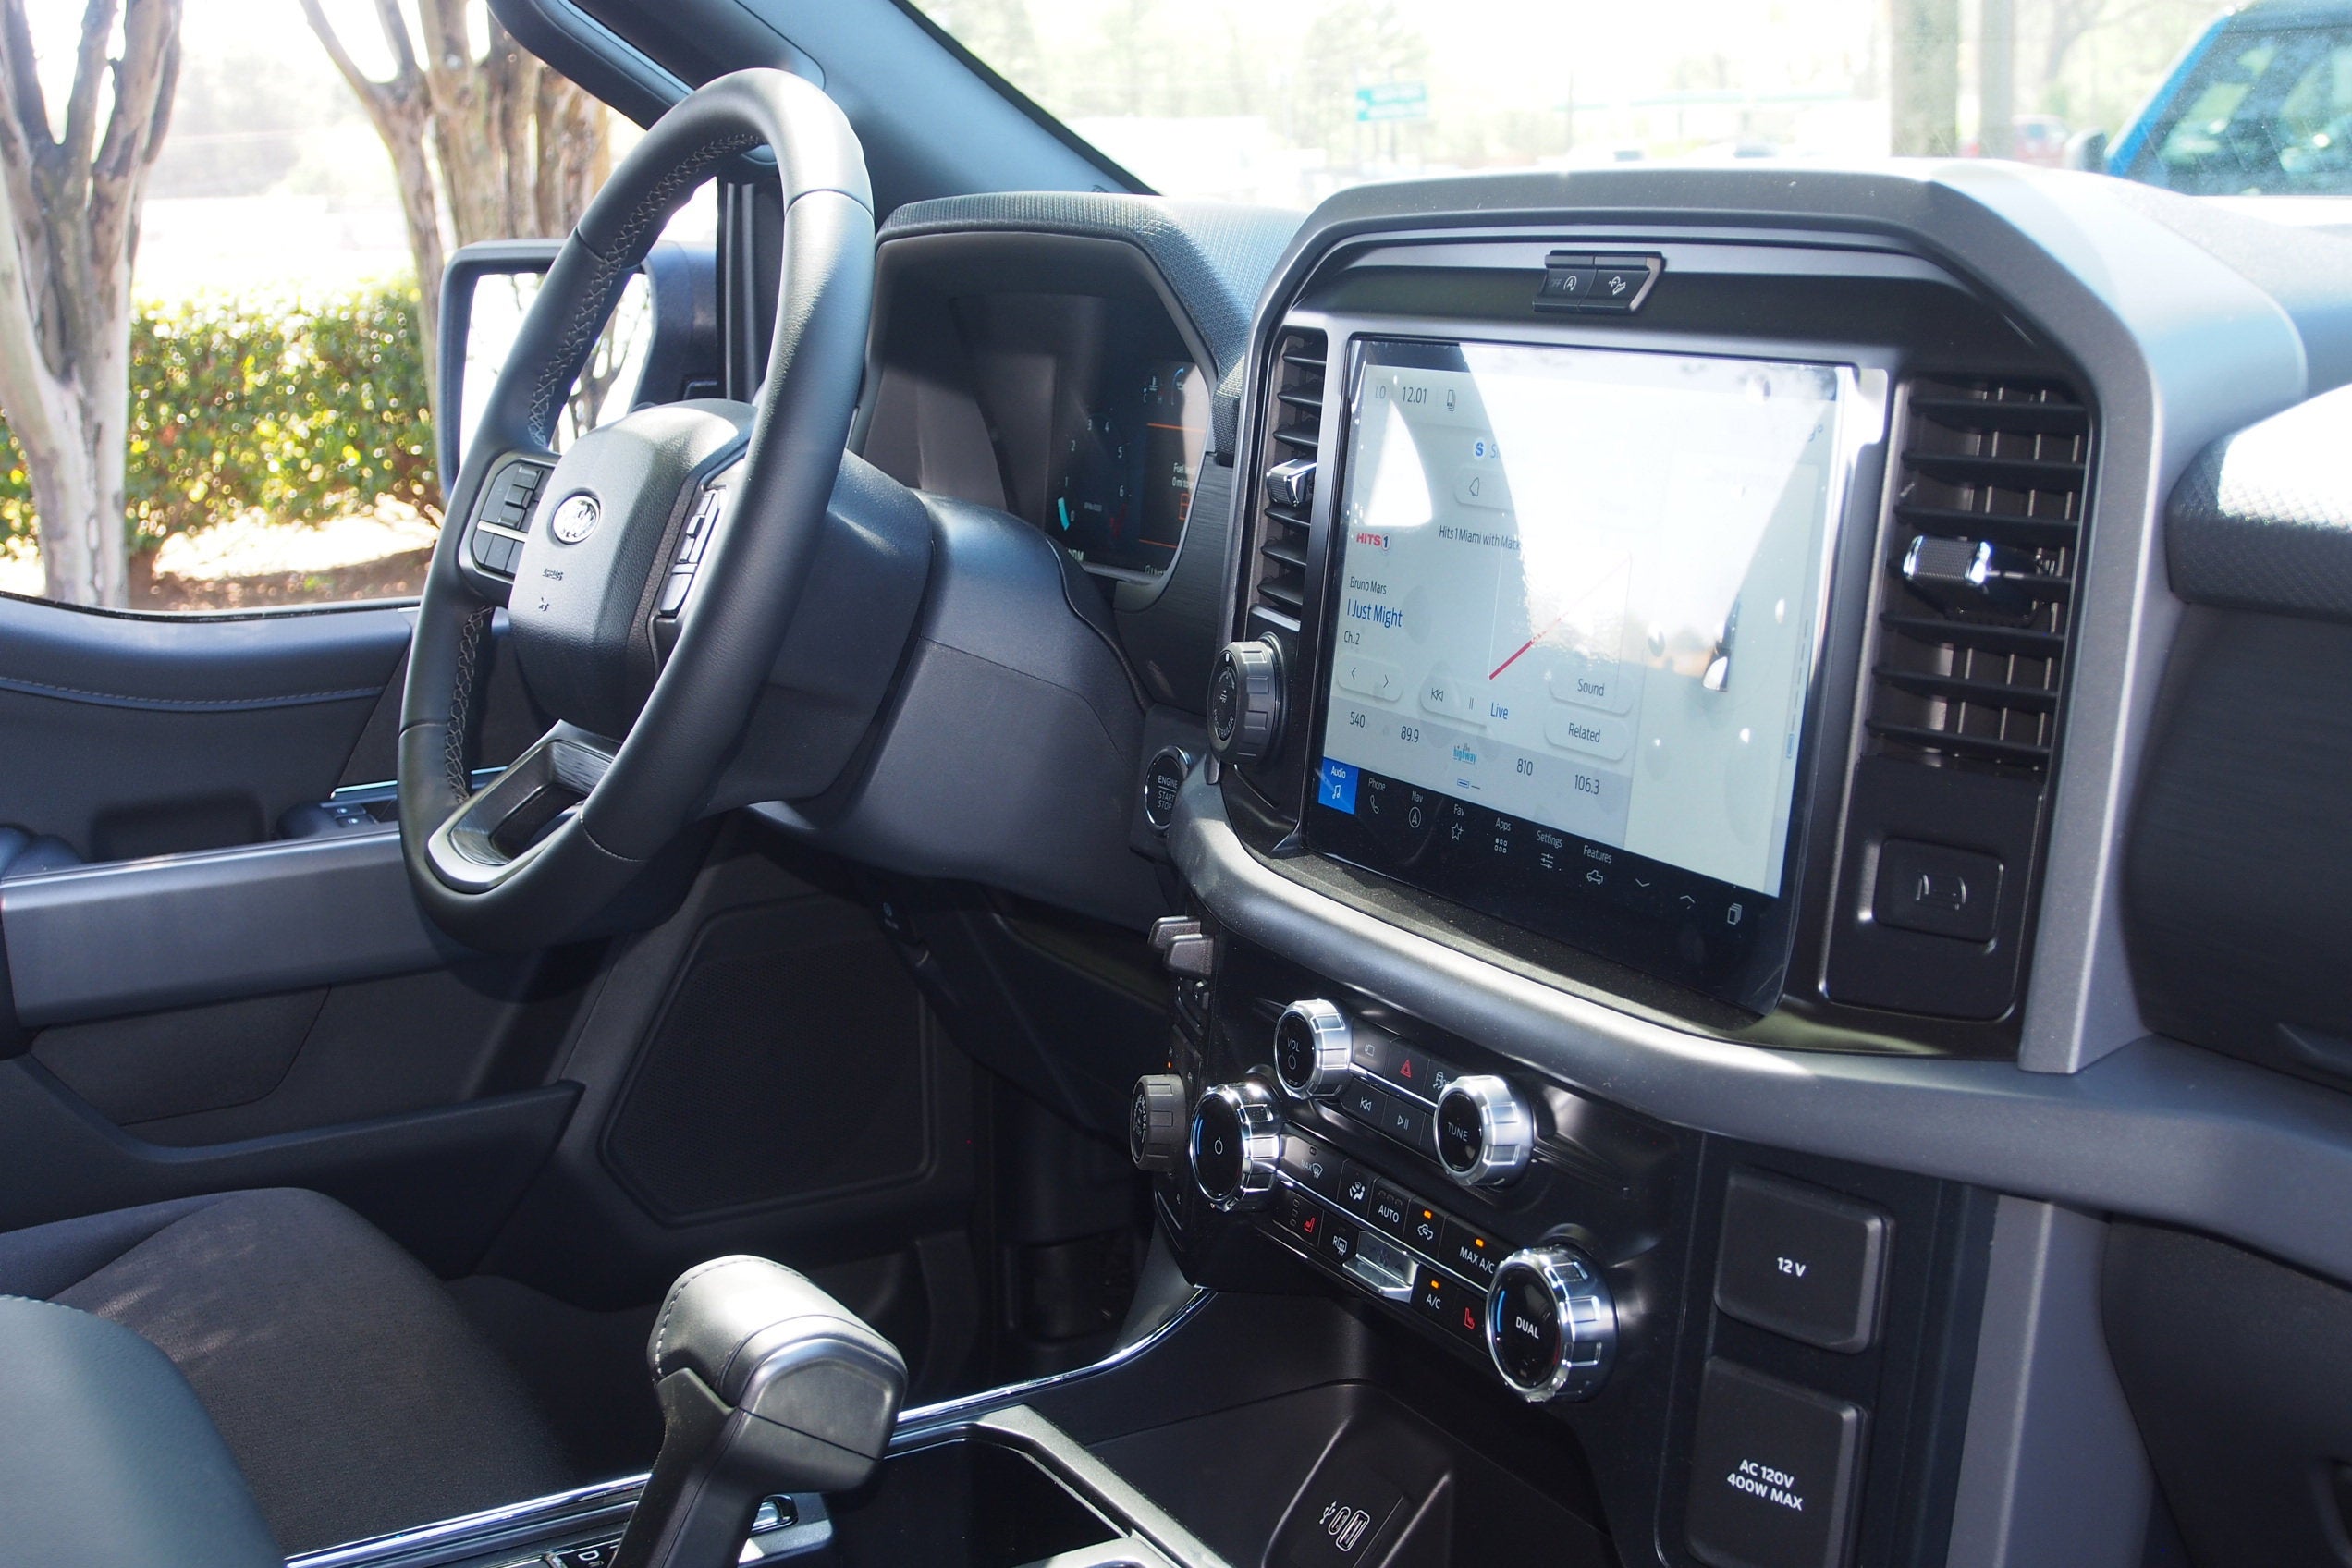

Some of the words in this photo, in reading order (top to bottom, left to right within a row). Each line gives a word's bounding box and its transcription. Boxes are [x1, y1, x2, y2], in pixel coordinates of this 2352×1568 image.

[1402, 386, 1427, 403] 12:01
[1118, 447, 1123, 459] 5
[1119, 484, 1124, 497] 6
[1439, 524, 1454, 540] Hits
[1458, 528, 1482, 545] Miami
[1482, 533, 1501, 547] with
[1350, 576, 1370, 593] Bruno
[1370, 581, 1388, 596] Mars
[1351, 600, 1372, 620] Just
[1373, 604, 1403, 629] Might
[1343, 631, 1355, 644] Ch.
[1355, 633, 1361, 646] 2
[1577, 678, 1605, 697] Sound
[1349, 711, 1366, 729] 540
[1490, 702, 1509, 720] Live
[1401, 726, 1420, 743] 89.9
[1568, 722, 1601, 743] Related
[1330, 765, 1346, 779] Audio
[1516, 758, 1534, 777] 810
[1158, 775, 1178, 789] ENGINE
[1368, 777, 1386, 792] Phone
[1574, 774, 1600, 796] 106.3
[1158, 790, 1175, 802] START
[1411, 790, 1424, 803] Nav
[1158, 801, 1172, 811] STOP
[1453, 803, 1465, 817] Fav
[1495, 817, 1513, 832] Apps
[1536, 829, 1562, 849] Settings
[1583, 844, 1612, 864] Features
[1286, 1038, 1301, 1054] VOL
[1448, 1121, 1469, 1143] TUNE
[1301, 1158, 1313, 1172] MAX
[1378, 1204, 1400, 1224] AUTO
[1459, 1246, 1480, 1268] MAX
[1479, 1254, 1495, 1275] A/C
[1426, 1292, 1442, 1311] A/C
[1515, 1315, 1540, 1340] DUAL
[1739, 1458, 1758, 1478] AC
[1759, 1465, 1795, 1488] 120V
[1726, 1472, 1768, 1499] 400W
[1770, 1487, 1804, 1511] MAX
